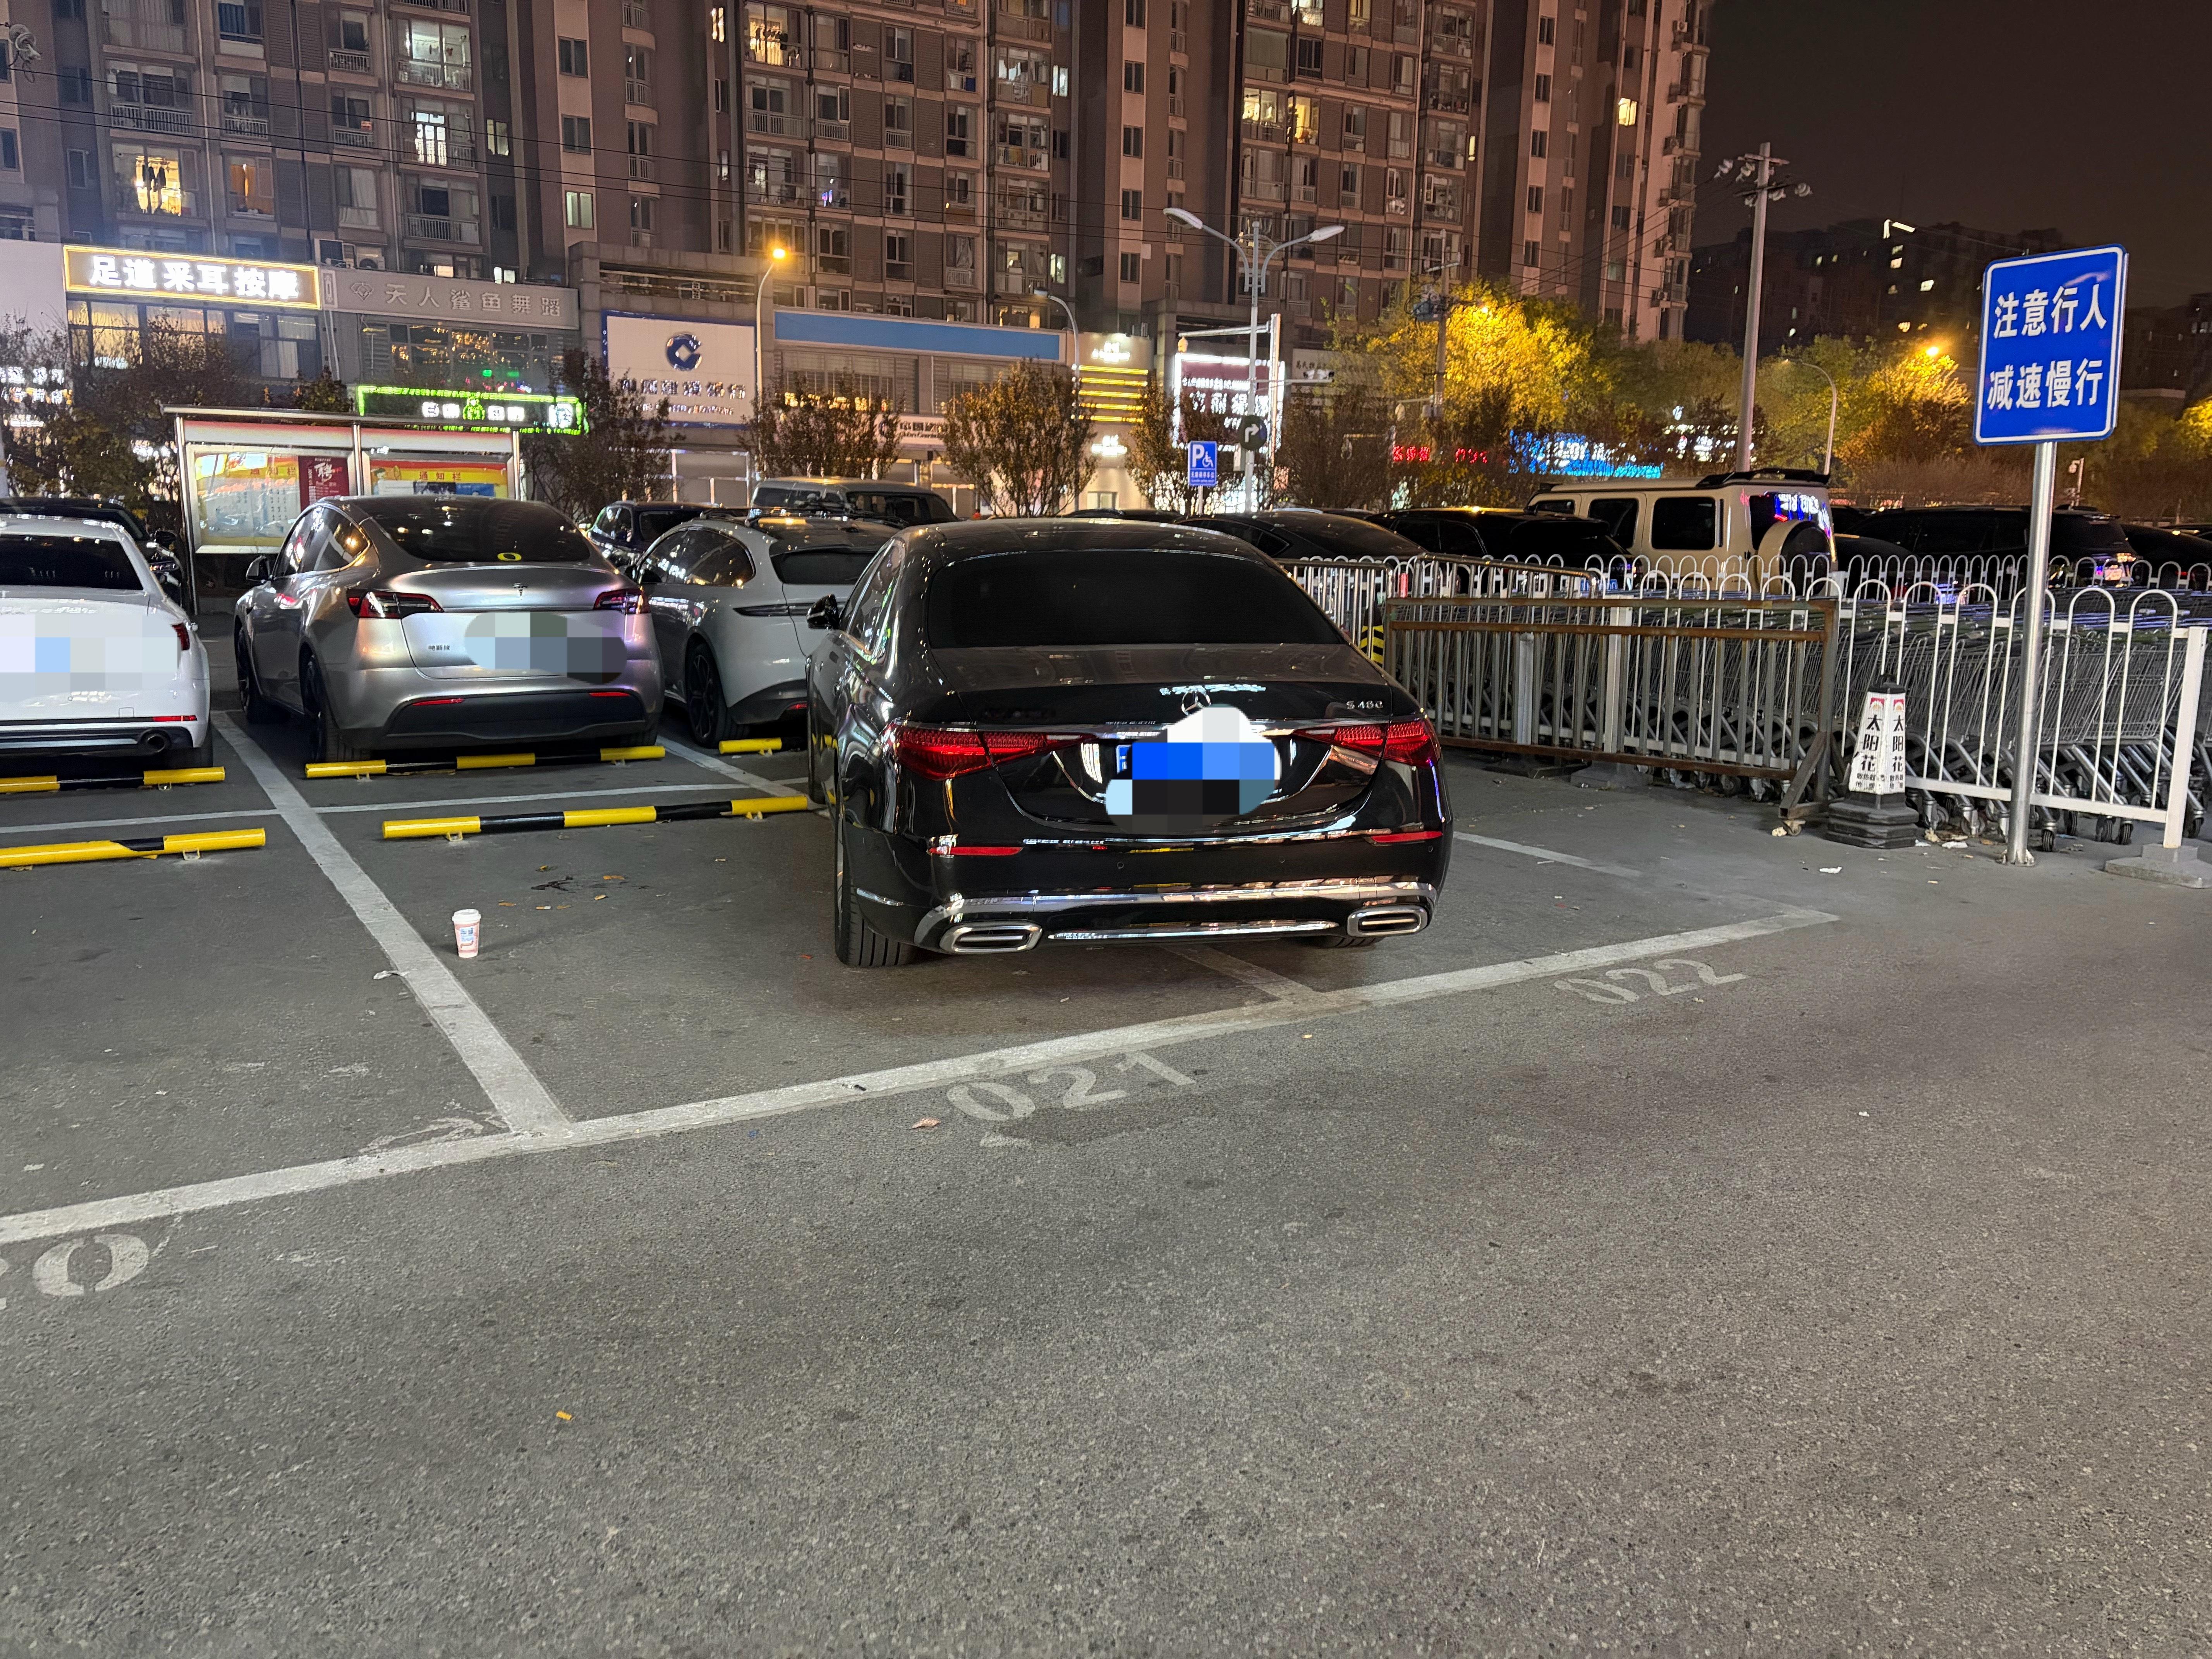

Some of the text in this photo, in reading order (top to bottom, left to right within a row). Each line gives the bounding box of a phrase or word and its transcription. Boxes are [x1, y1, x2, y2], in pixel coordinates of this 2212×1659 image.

[89, 255, 300, 300] 足道采耳按摩
[385, 283, 560, 317] 天人鲨鱼舞蹈
[1993, 283, 2107, 339] 注意行人
[1986, 358, 2103, 410] 减速慢行
[419, 471, 461, 481] 通知栏
[1192, 444, 1205, 467] P
[1346, 700, 1355, 709] S
[1860, 714, 1883, 771] 太阳花
[1892, 715, 1904, 772] 太阳花
[1553, 959, 1748, 1005] 022
[947, 1051, 1196, 1121] 021
[0, 1234, 149, 1310] 0
